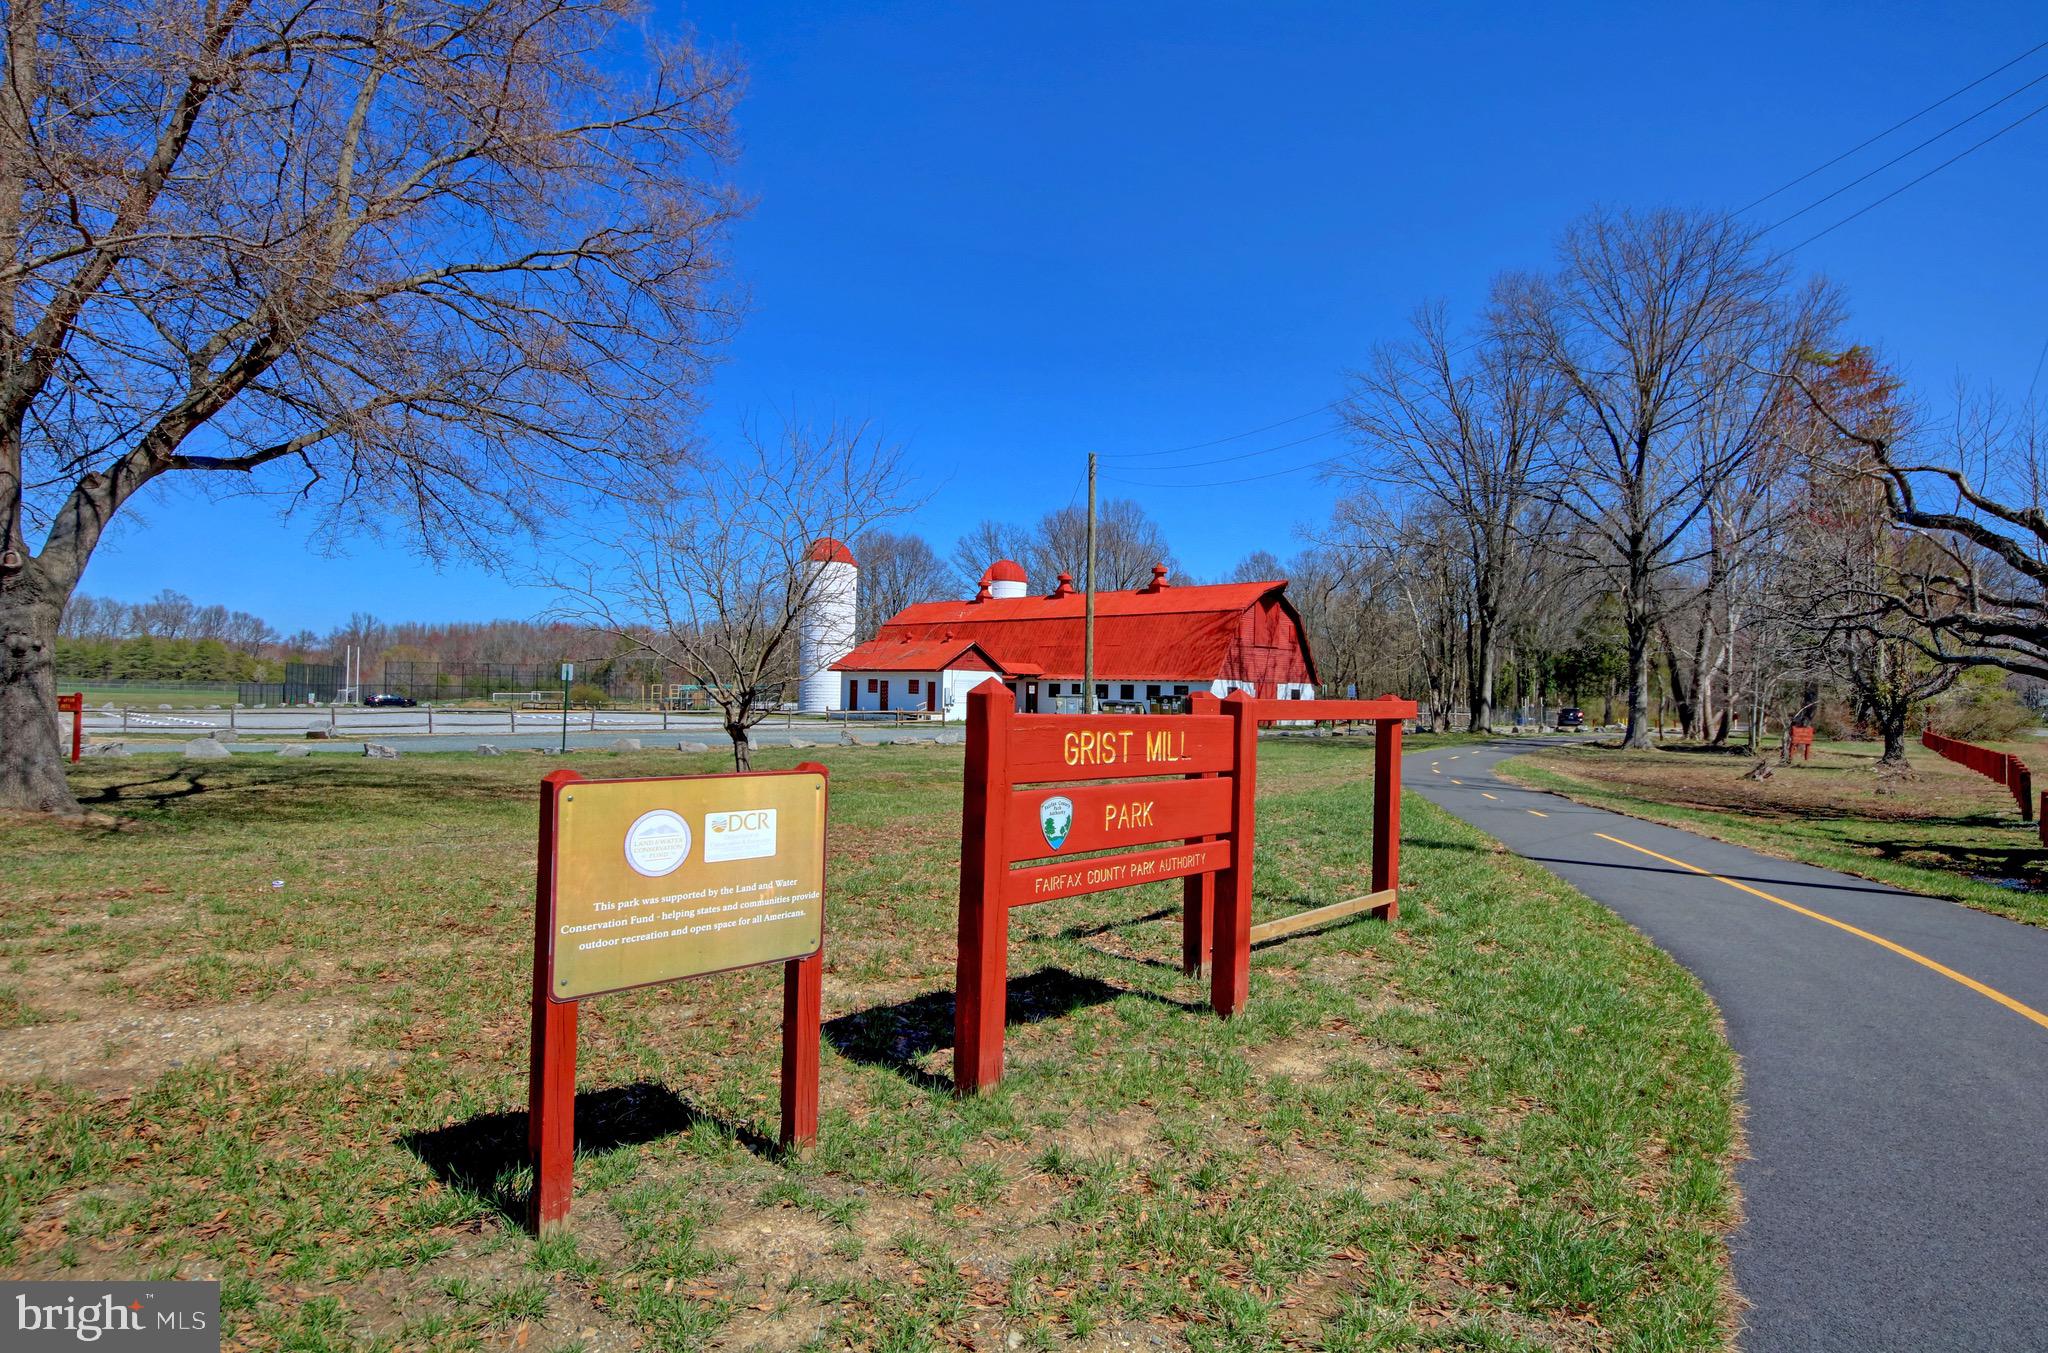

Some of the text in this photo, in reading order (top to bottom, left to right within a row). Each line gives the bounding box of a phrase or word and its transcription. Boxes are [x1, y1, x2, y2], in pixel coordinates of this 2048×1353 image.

[1064, 731, 1192, 766] GRIST MILL
[728, 812, 770, 832] DCR
[1105, 801, 1154, 831] PARK
[1035, 853, 1207, 894] FAIRFAX COUNTY PARK AUTHORITY
[560, 919, 628, 935] Conservation
[630, 913, 654, 924] Fund
[661, 909, 695, 921] helping
[697, 905, 721, 915] states
[722, 902, 738, 911] and
[740, 895, 790, 908] communities
[791, 891, 820, 903] provide
[592, 901, 615, 912] This
[617, 898, 640, 911] park
[661, 889, 706, 904] supported
[708, 889, 718, 898] by
[720, 886, 734, 895] the
[736, 883, 757, 893] Land
[758, 881, 773, 890] and
[775, 879, 798, 887] Water
[579, 910, 806, 951] outdoor recreation and open space for all Americans.
